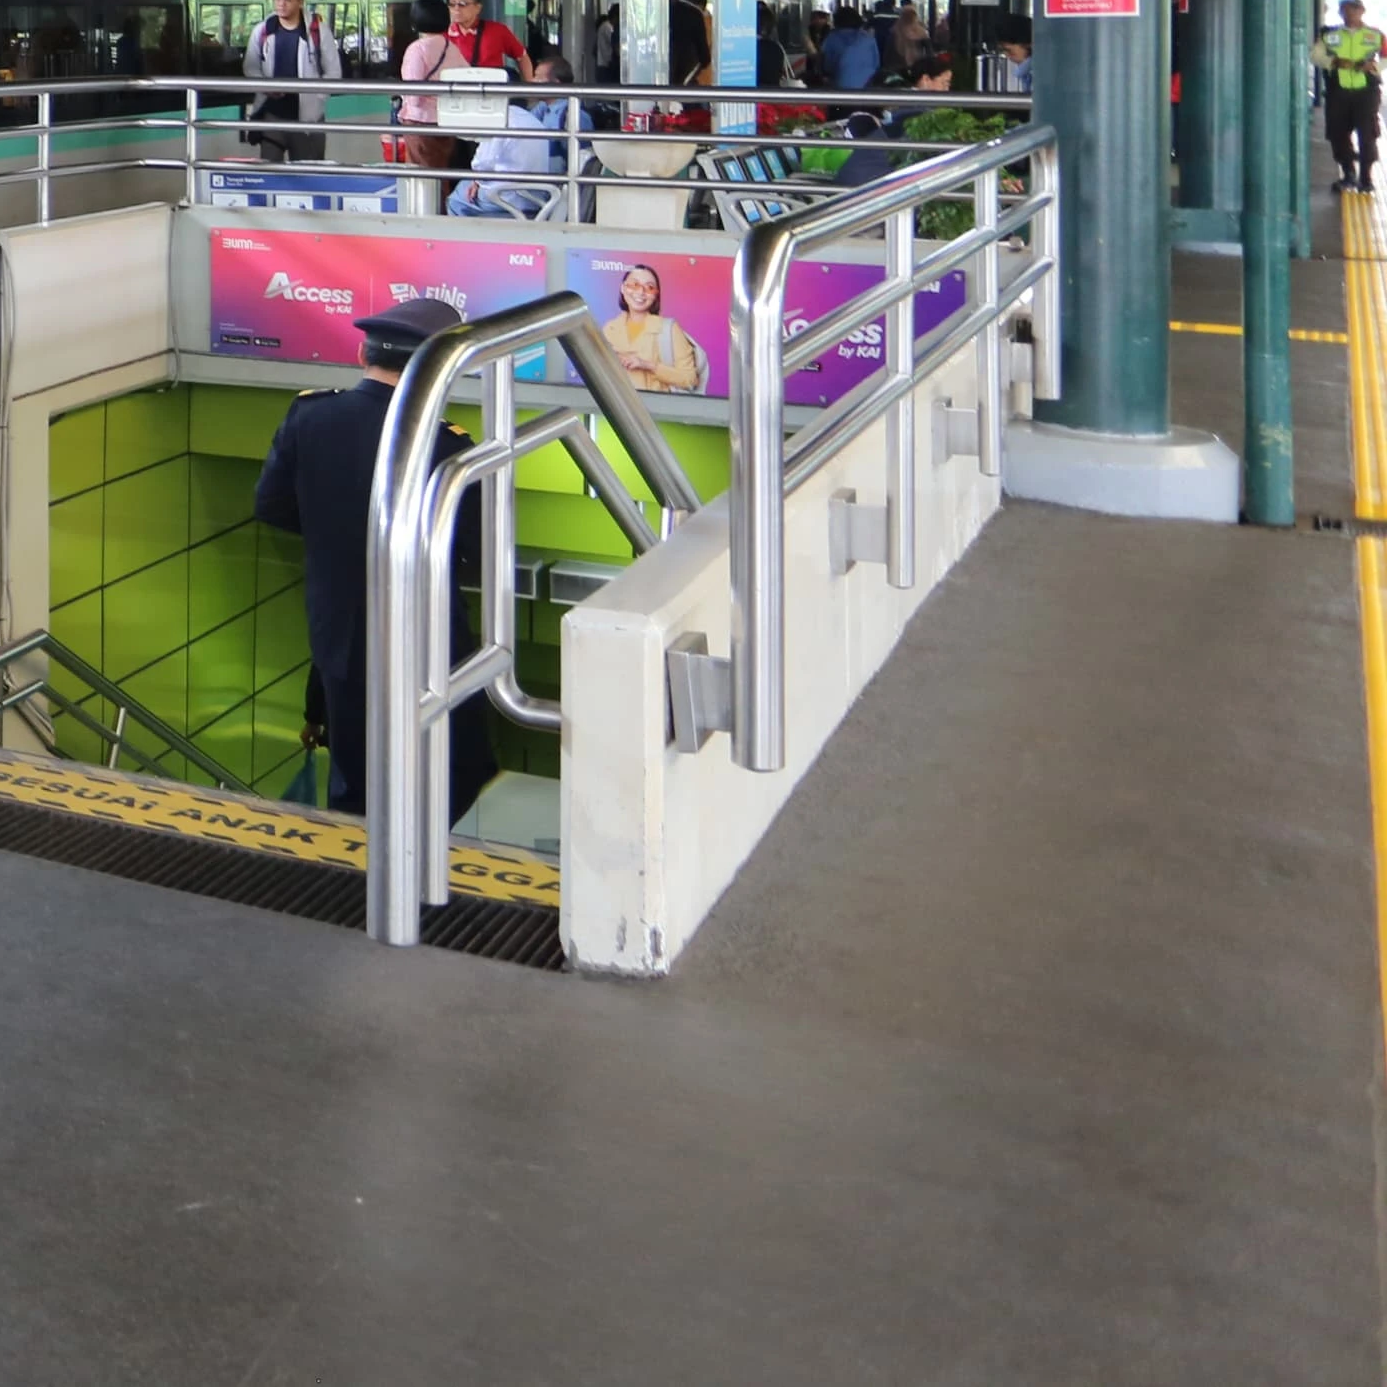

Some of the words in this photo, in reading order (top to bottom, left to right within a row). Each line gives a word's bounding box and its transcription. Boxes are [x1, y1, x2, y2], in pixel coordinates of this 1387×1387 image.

[509, 253, 534, 266] KAI
[263, 272, 354, 304] Access
[324, 304, 335, 314] by
[336, 305, 353, 314] KAI
[838, 344, 853, 358] by
[856, 345, 880, 359] KAI
[168, 807, 323, 845] ANAK
